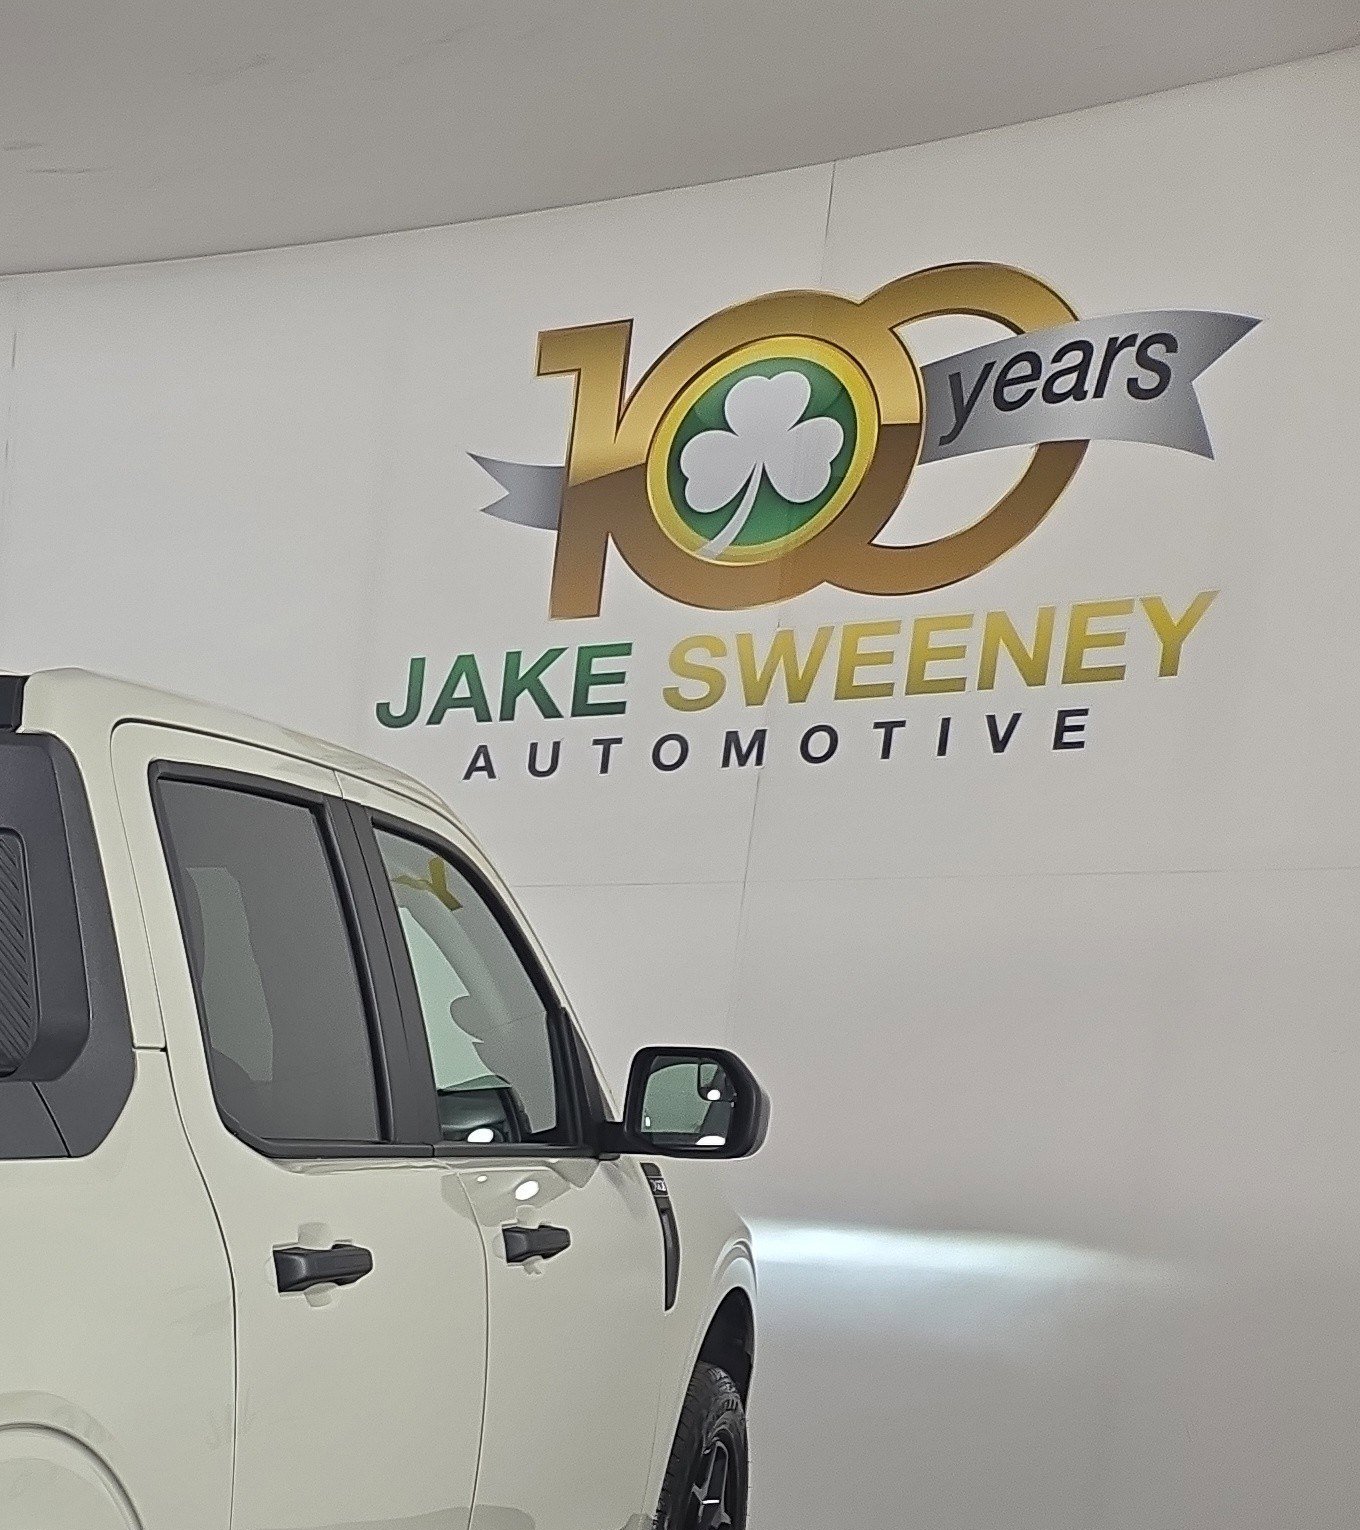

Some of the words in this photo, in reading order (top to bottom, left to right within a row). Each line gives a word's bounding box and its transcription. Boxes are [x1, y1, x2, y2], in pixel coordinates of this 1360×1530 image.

[535, 261, 1090, 620] 100
[938, 330, 1179, 447] years
[374, 641, 633, 730] JAKE
[662, 589, 1221, 713] SWEENEY
[462, 708, 1092, 781] AUTOMOTIVE
